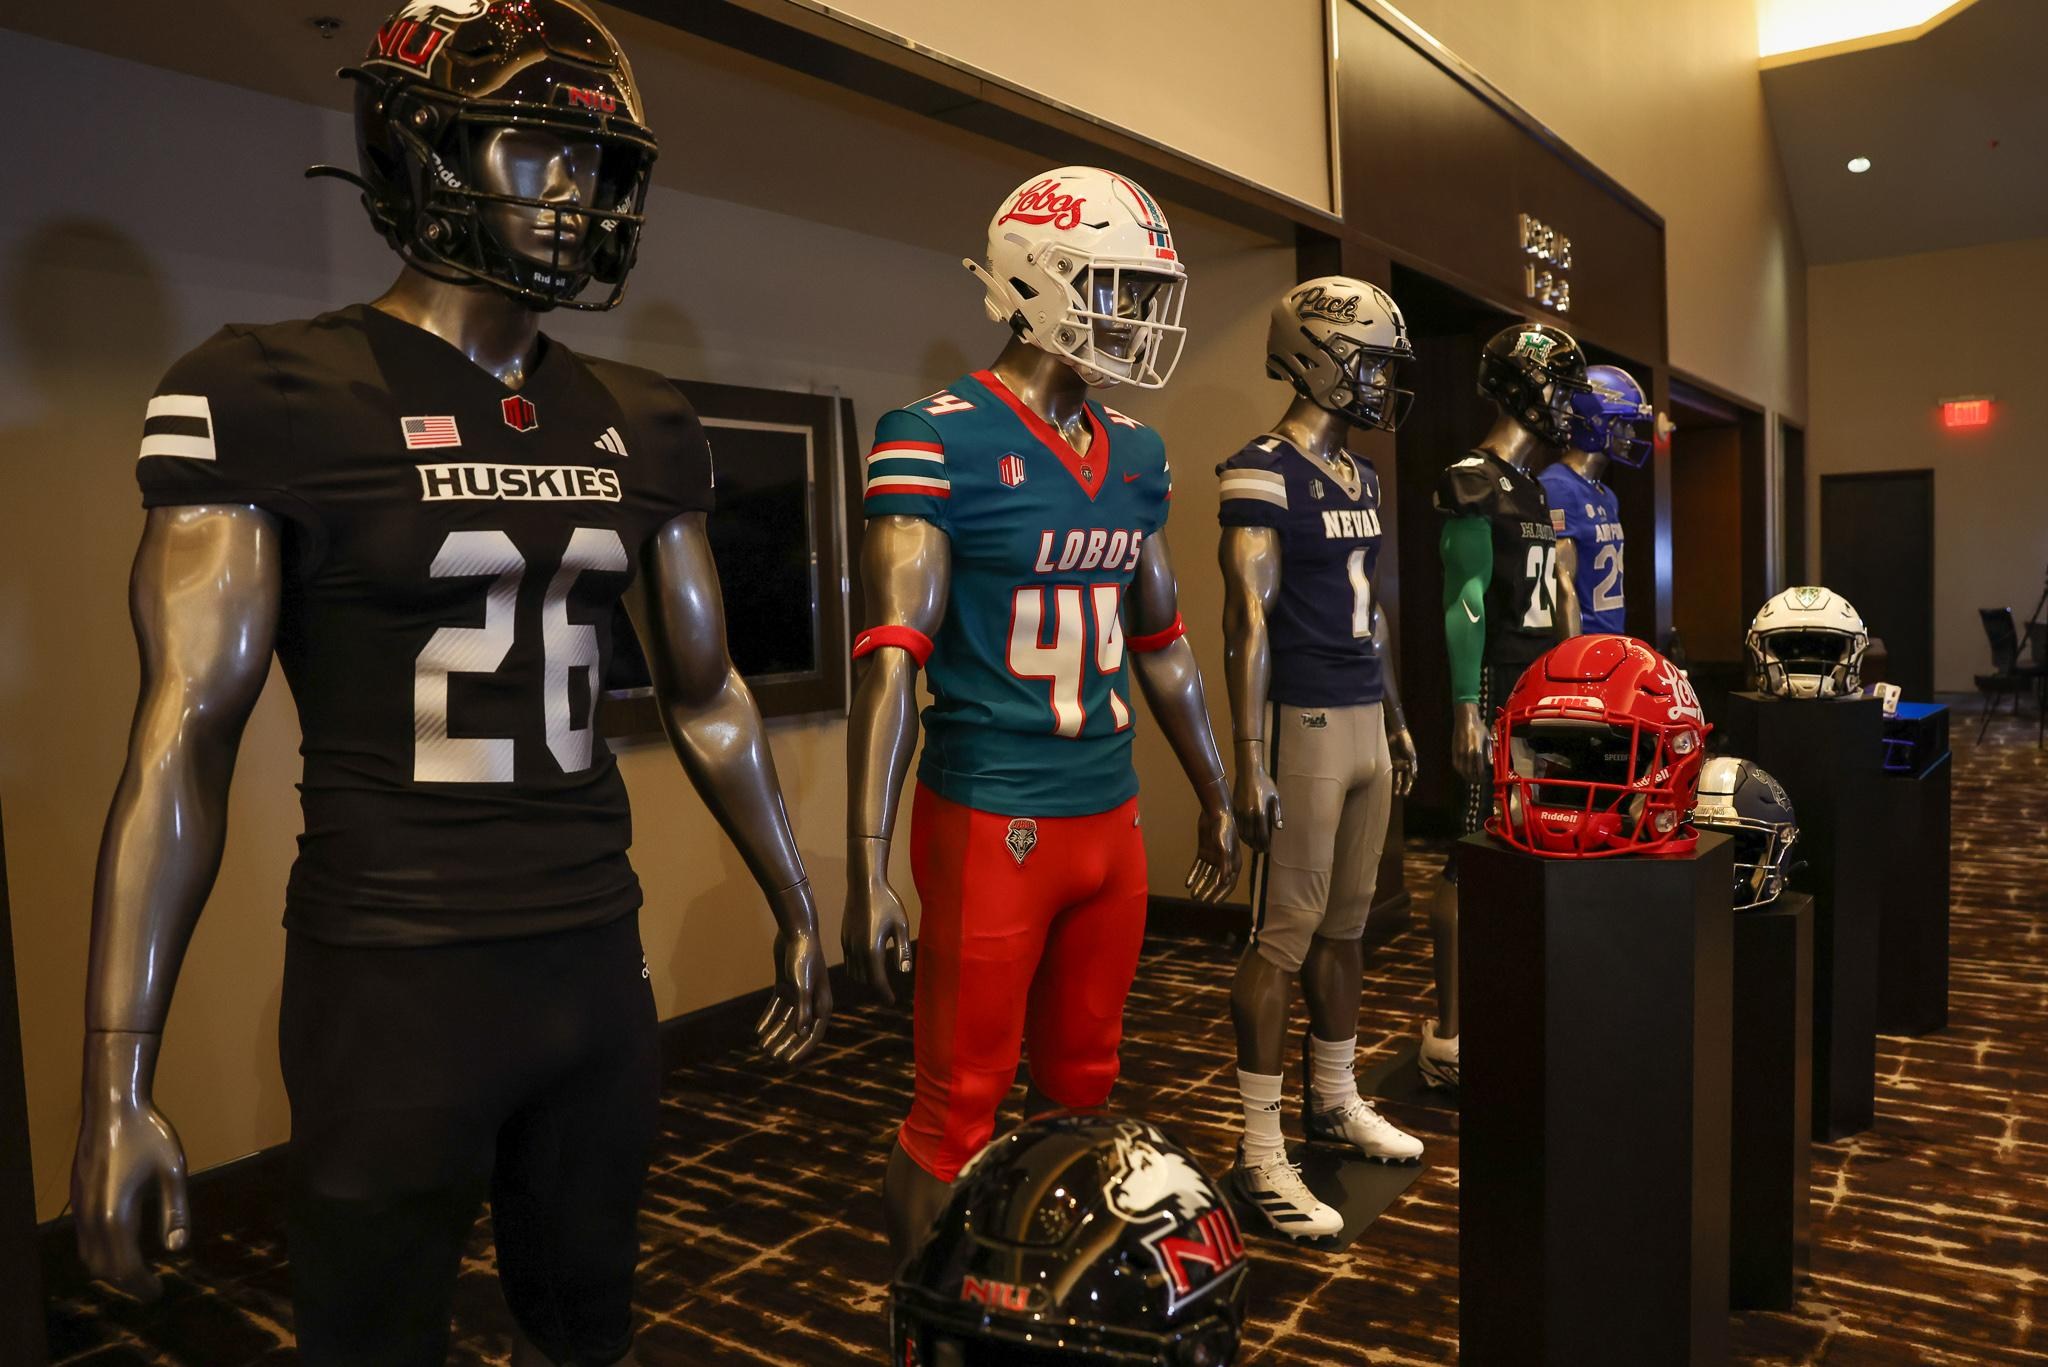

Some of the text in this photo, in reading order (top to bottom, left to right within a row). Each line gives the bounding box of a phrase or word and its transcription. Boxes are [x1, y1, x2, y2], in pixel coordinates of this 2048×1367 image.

[568, 86, 616, 113] NIU
[998, 179, 1086, 231] Lobos
[533, 272, 567, 287] Ridell
[1297, 286, 1360, 327] Pack
[416, 464, 623, 502] HUSKIES
[1033, 527, 1143, 574] LOBOS
[1346, 545, 1373, 639] 1
[1593, 542, 1625, 612] 2
[413, 526, 629, 783] 26
[1540, 810, 1579, 824] Riddell
[960, 1274, 1031, 1312] NIU
